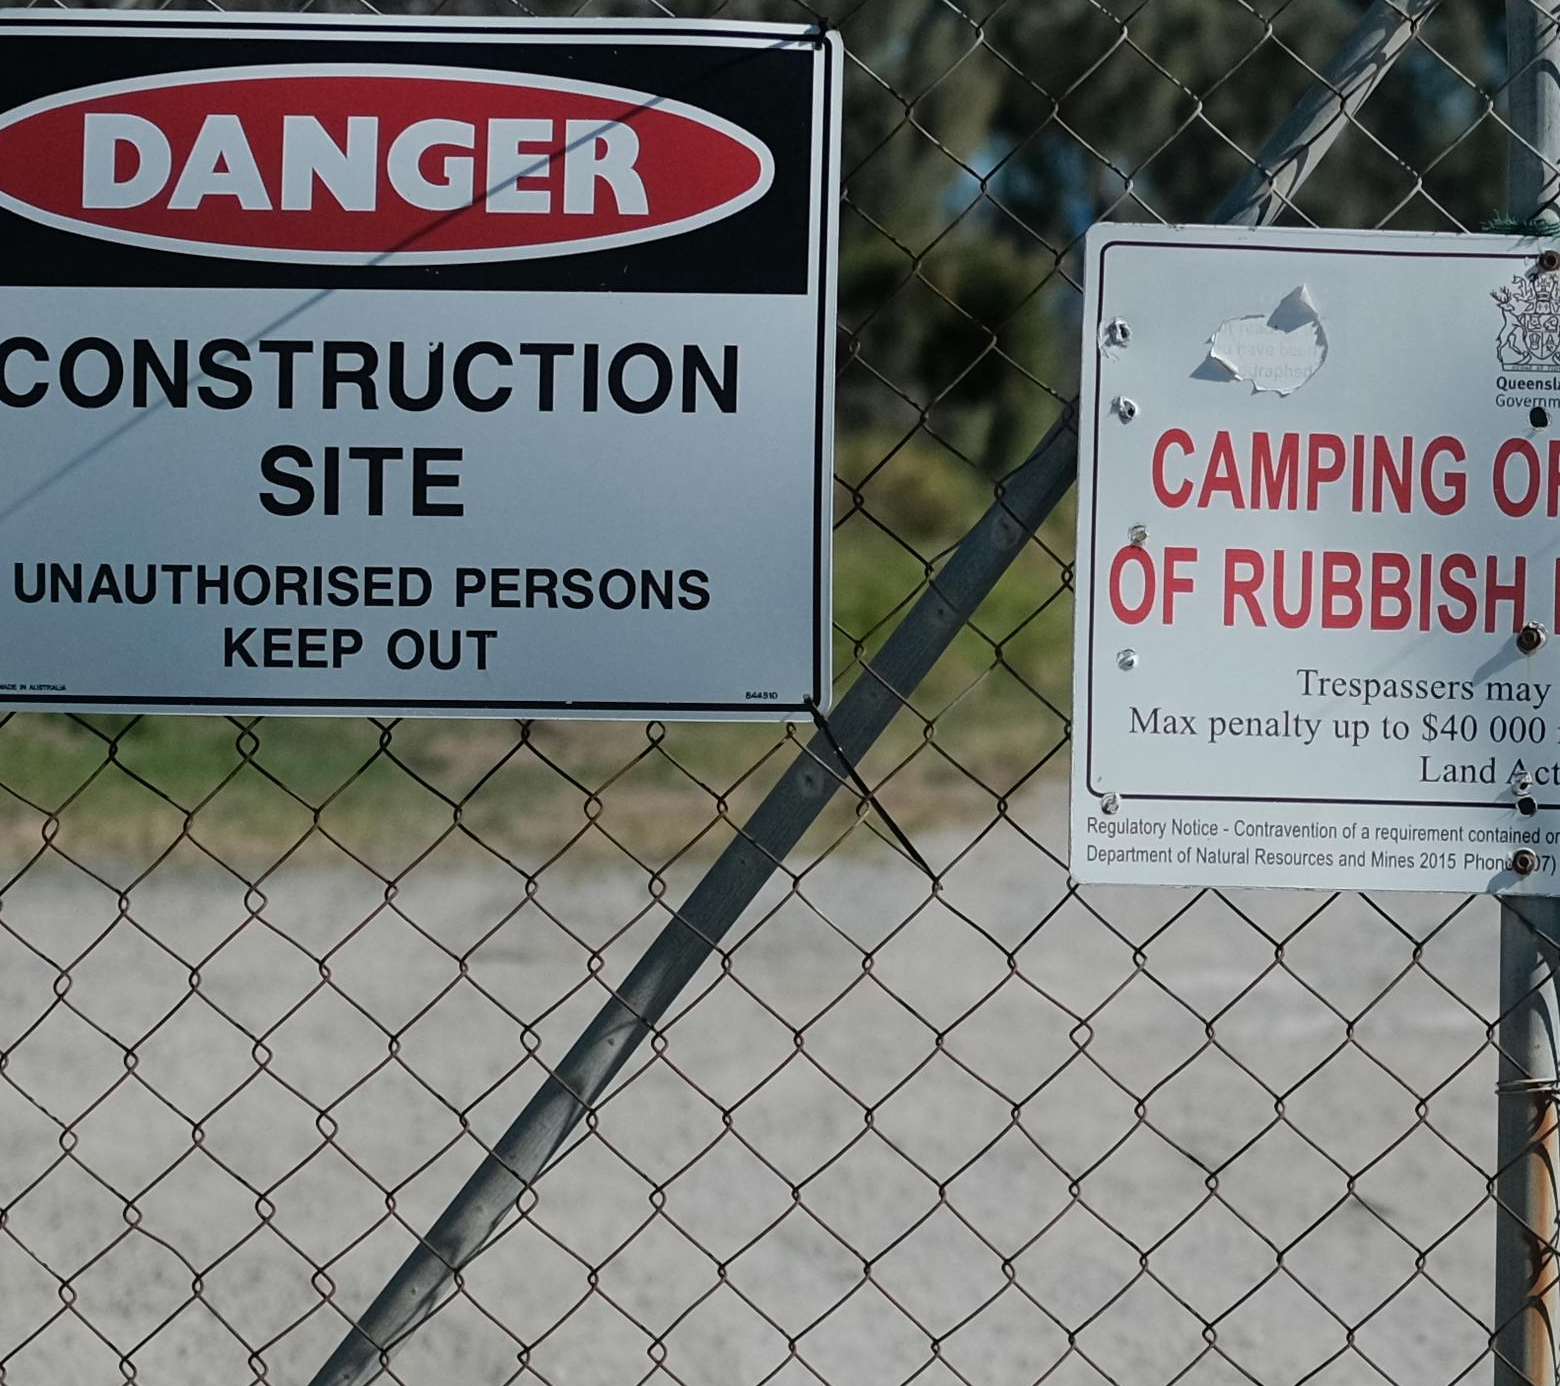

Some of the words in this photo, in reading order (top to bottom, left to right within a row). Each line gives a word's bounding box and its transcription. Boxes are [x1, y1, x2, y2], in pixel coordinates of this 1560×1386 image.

[83, 113, 649, 215] DANGER
[259, 445, 463, 516] SITE
[1152, 428, 1466, 514] CAMPING
[15, 563, 432, 606] UNAUTHORISED
[456, 568, 710, 610] PERSONS
[1109, 545, 1198, 624] OF
[1224, 549, 1525, 633] RUBBISH
[224, 628, 363, 668] KEEP
[388, 629, 497, 670] OUT
[1296, 667, 1475, 705] Trespassers
[1487, 683, 1551, 709] may
[1130, 707, 1197, 734] Max
[1208, 710, 1321, 745] penalty
[1334, 720, 1369, 746] up
[1383, 717, 1409, 740] to
[1423, 713, 1477, 741] $40
[1490, 716, 1545, 743] 000
[1421, 756, 1496, 784] Land
[1088, 817, 1166, 839] Regulatory
[1172, 819, 1218, 836] Notice
[1234, 820, 1336, 838] Contravention
[1343, 823, 1357, 839] of
[1361, 827, 1369, 839] a
[1376, 825, 1463, 843] requirement
[1468, 826, 1541, 845] contained
[1087, 845, 1172, 865] Department
[1177, 847, 1191, 863] of
[1197, 847, 1249, 864] Natural
[1255, 848, 1333, 866] Resources
[1339, 851, 1365, 867] and
[1372, 851, 1414, 868] Mines
[1420, 853, 1456, 869] 2015
